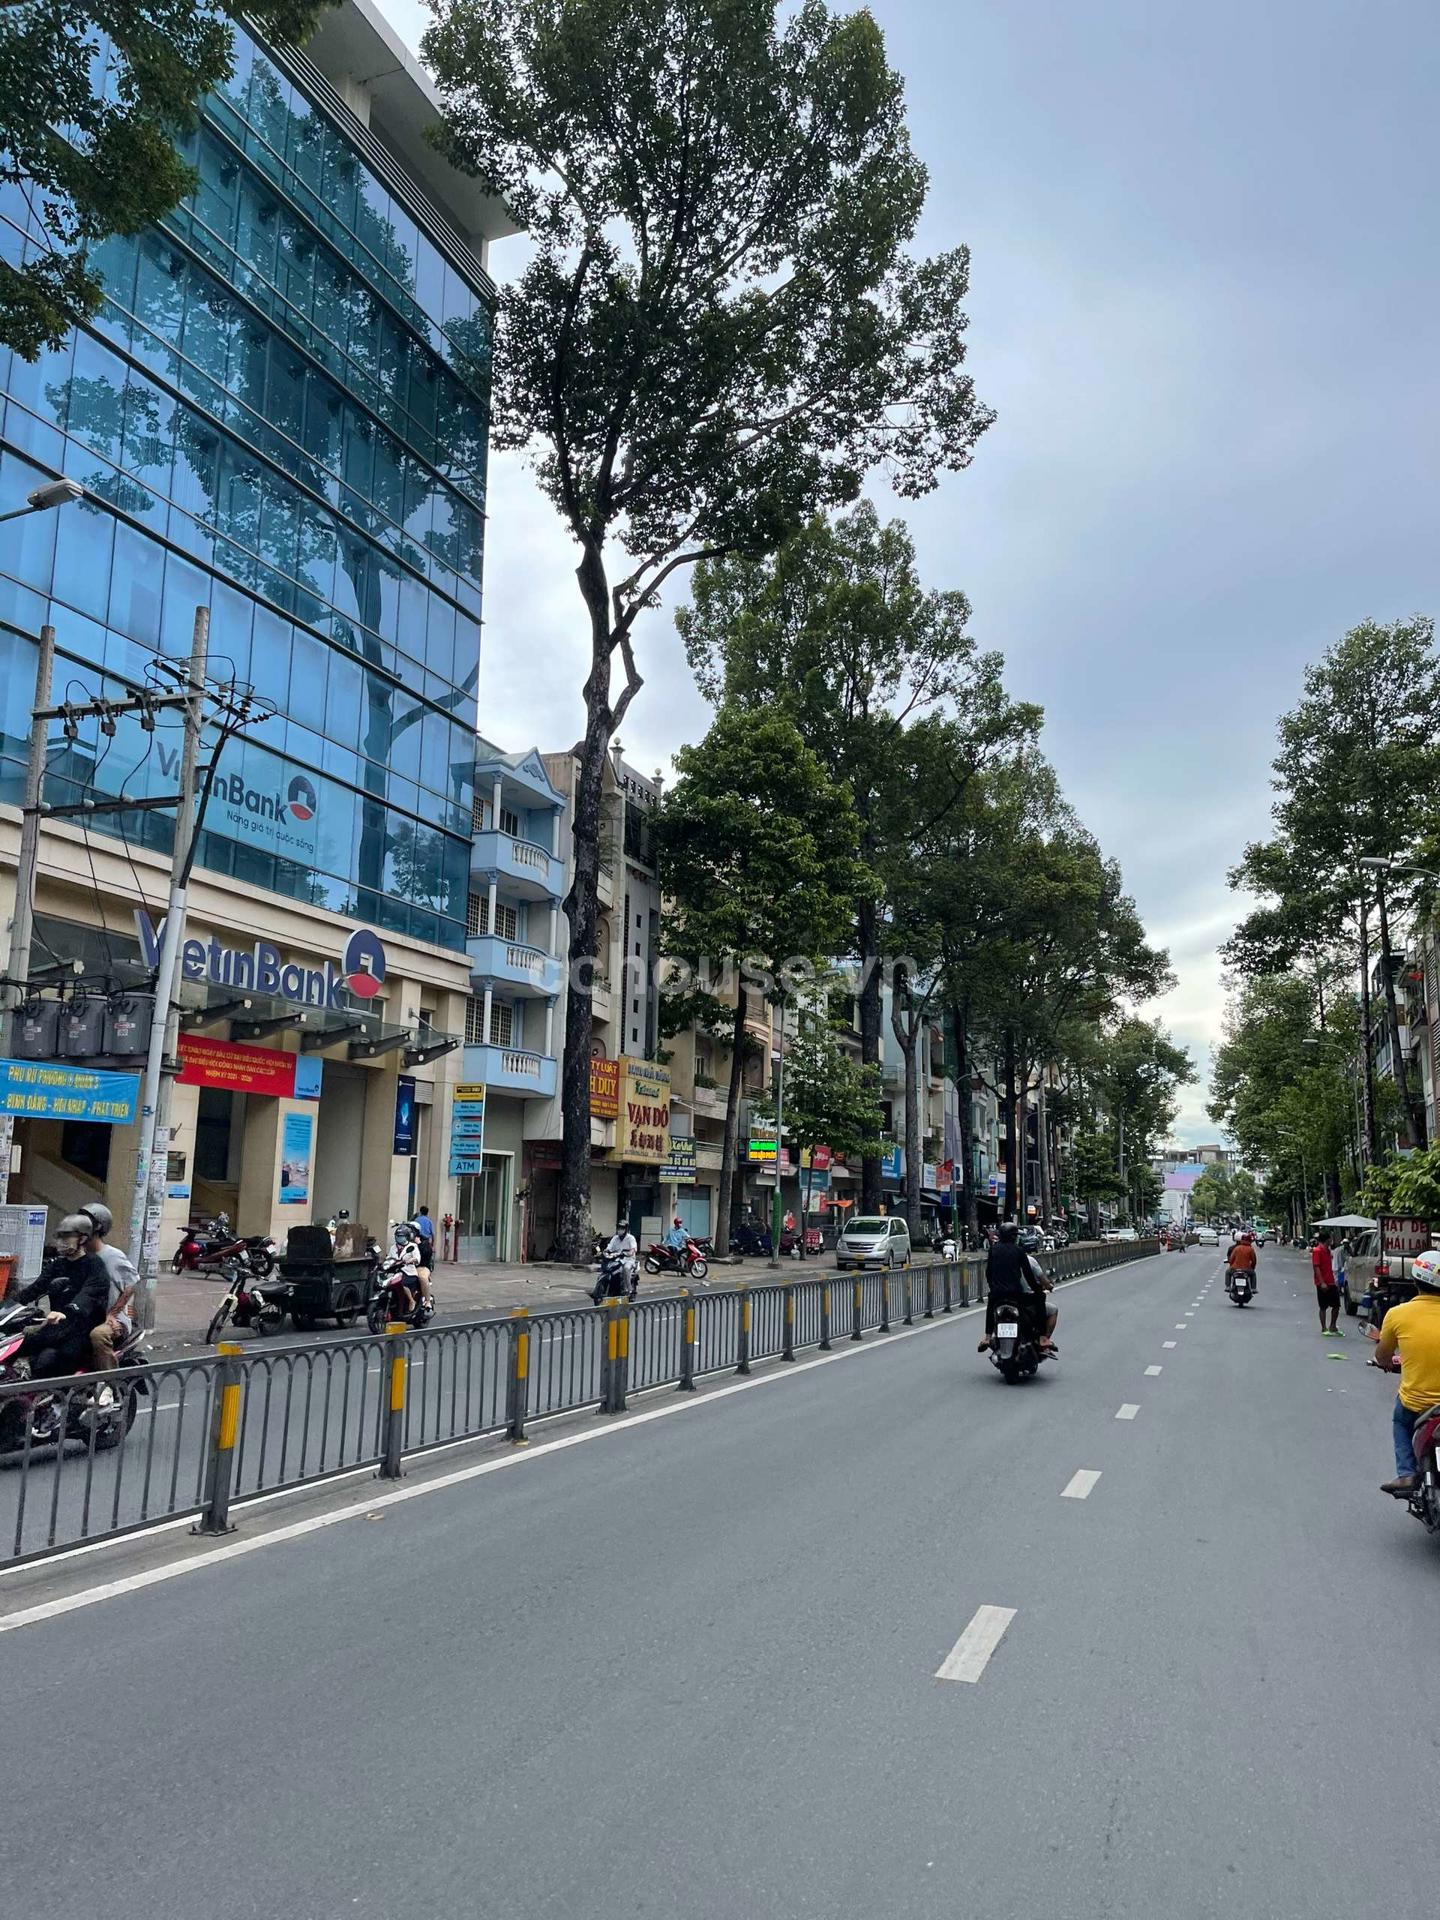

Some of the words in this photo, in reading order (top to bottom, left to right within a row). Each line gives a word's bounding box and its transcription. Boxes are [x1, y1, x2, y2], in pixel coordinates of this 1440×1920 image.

[133, 909, 346, 1010] VetinBank
[598, 1077, 616, 1097] DUY
[628, 1102, 652, 1128] VẠN
[456, 1161, 475, 1170] ATM
